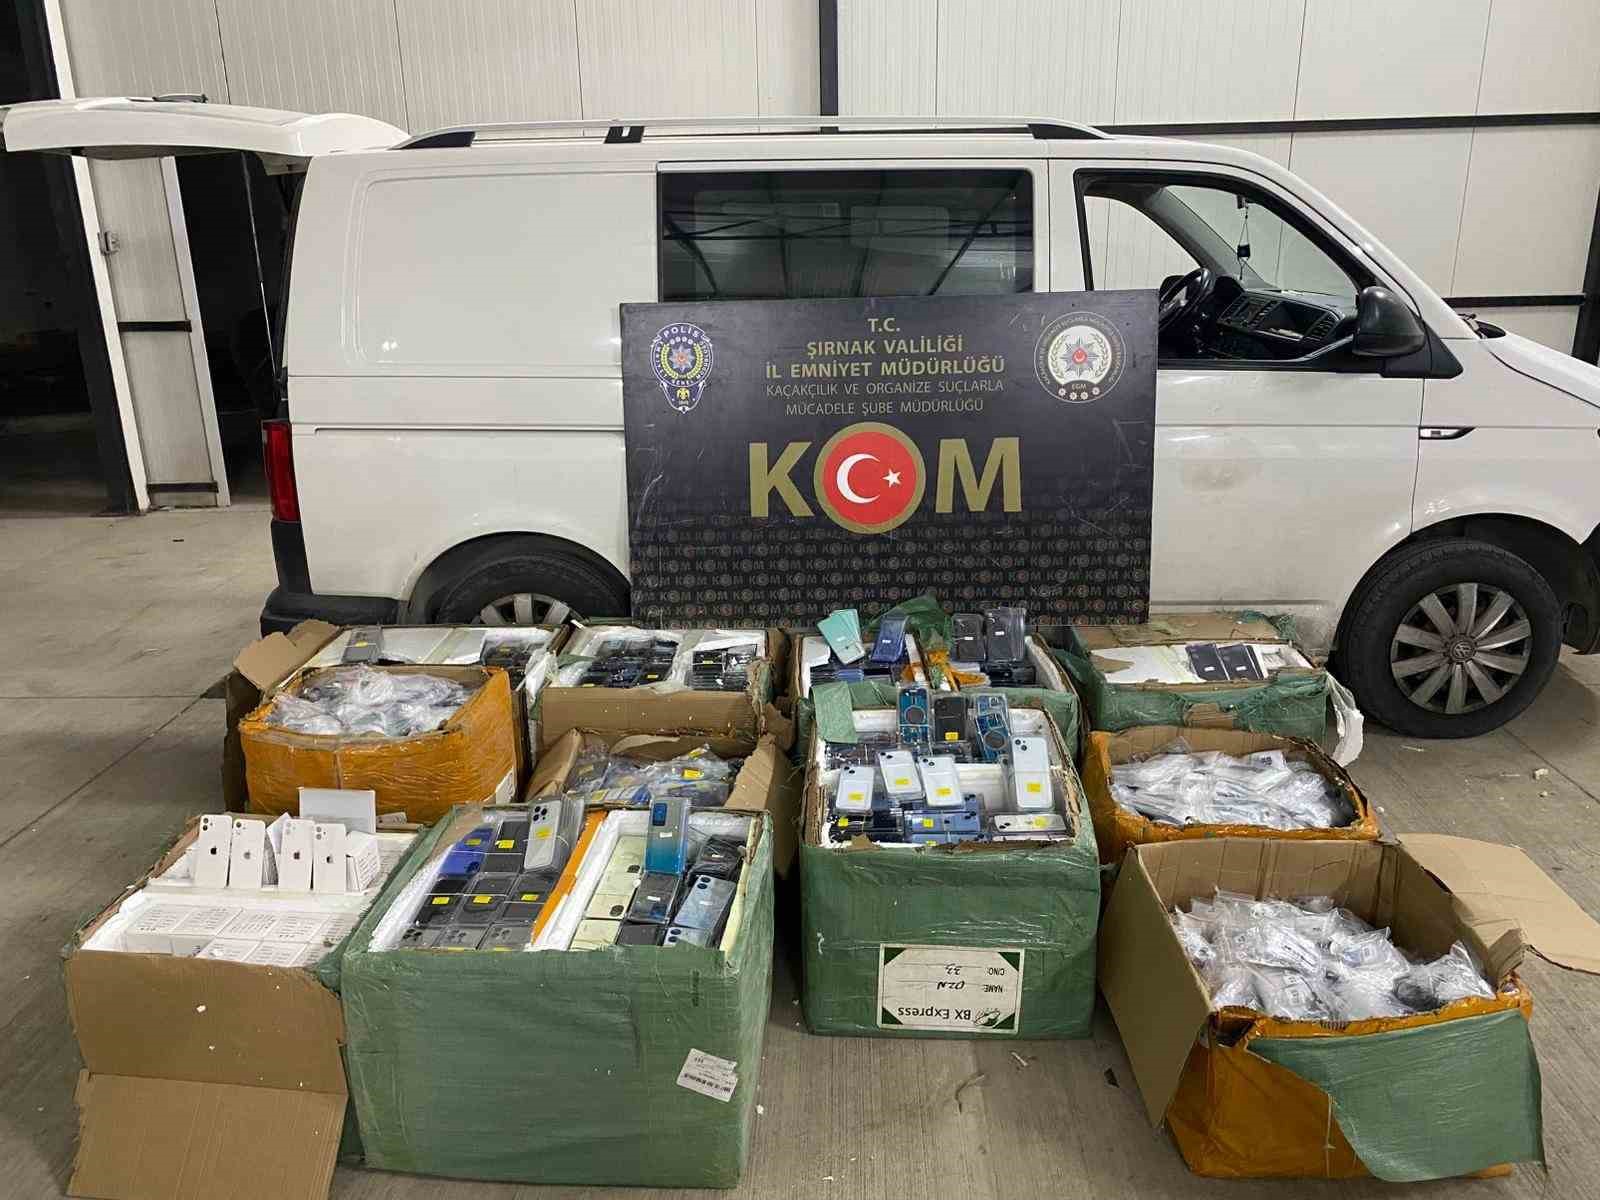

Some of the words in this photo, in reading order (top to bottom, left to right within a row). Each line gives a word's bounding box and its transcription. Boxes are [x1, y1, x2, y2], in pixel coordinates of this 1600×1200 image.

[868, 318, 901, 333] T.C.
[807, 341, 876, 359] ŞIRNAK
[884, 334, 963, 354] VALİLİĞİ
[766, 361, 782, 379] İL
[790, 359, 872, 378] EMNİYET
[881, 354, 1005, 376] MÜDÜRLÜĞÜ
[766, 383, 838, 399] KAÇAKÇILIK
[844, 383, 859, 395] VE
[939, 379, 1004, 395] SUÇLARLA
[785, 401, 855, 416] MÜCADELE
[862, 401, 893, 416] ŞUBE
[749, 422, 1023, 534] KOM
[898, 1006, 950, 1019] Express
[954, 1008, 971, 1020] BX
